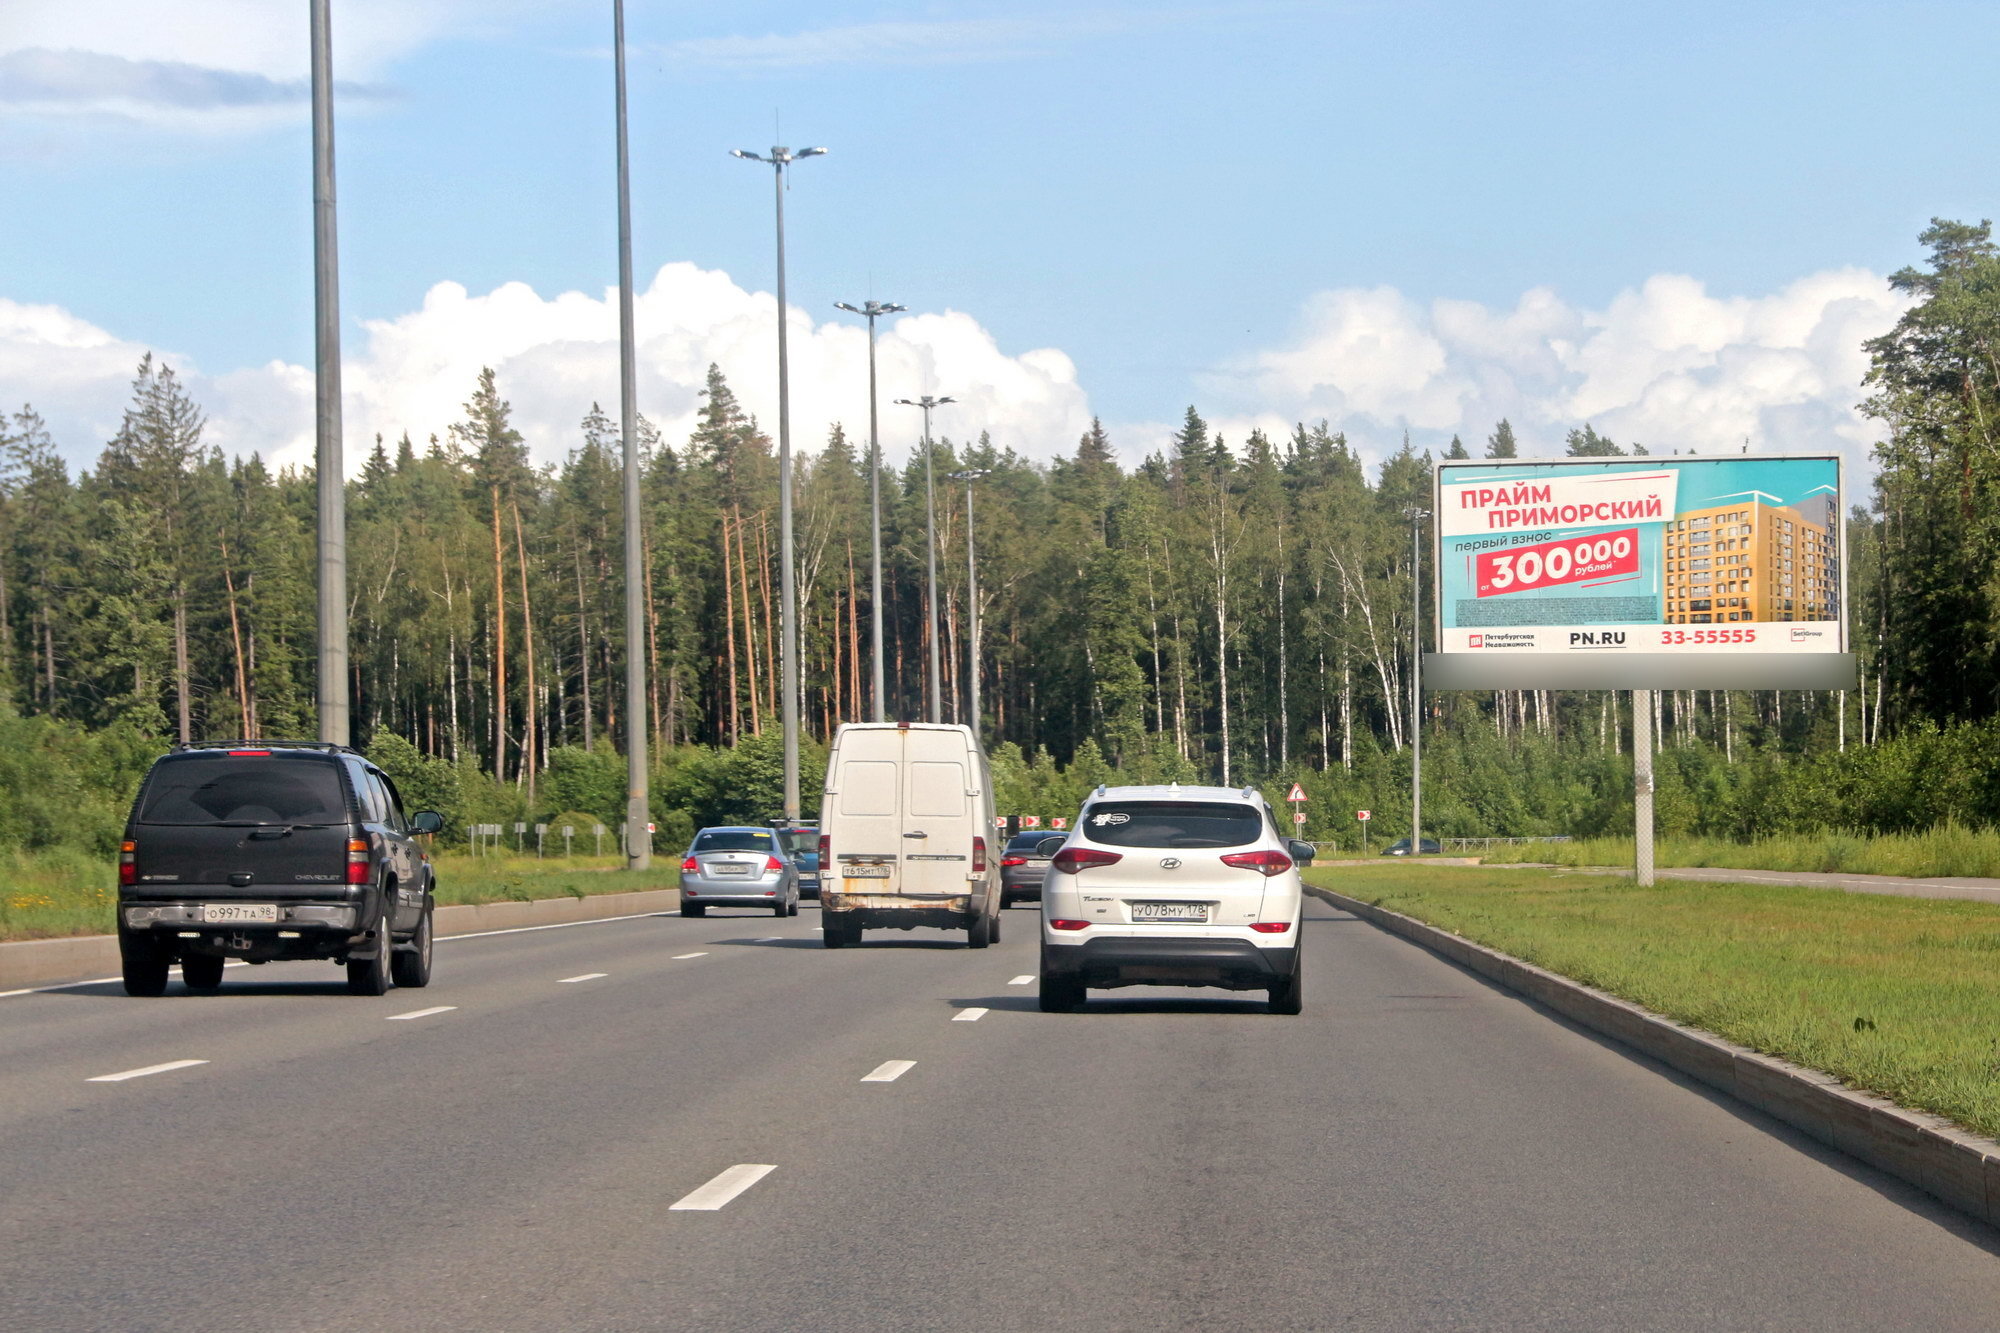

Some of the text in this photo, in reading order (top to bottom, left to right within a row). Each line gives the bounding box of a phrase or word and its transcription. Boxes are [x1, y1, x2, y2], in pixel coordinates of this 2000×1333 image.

[1461, 481, 1552, 508] ПРАЙМ
[1488, 494, 1662, 528] ПРИМОРСКИЙ
[1455, 532, 1552, 552] первый взнос
[1570, 632, 1626, 645] PN.RU
[1661, 629, 1756, 644] 33-55555
